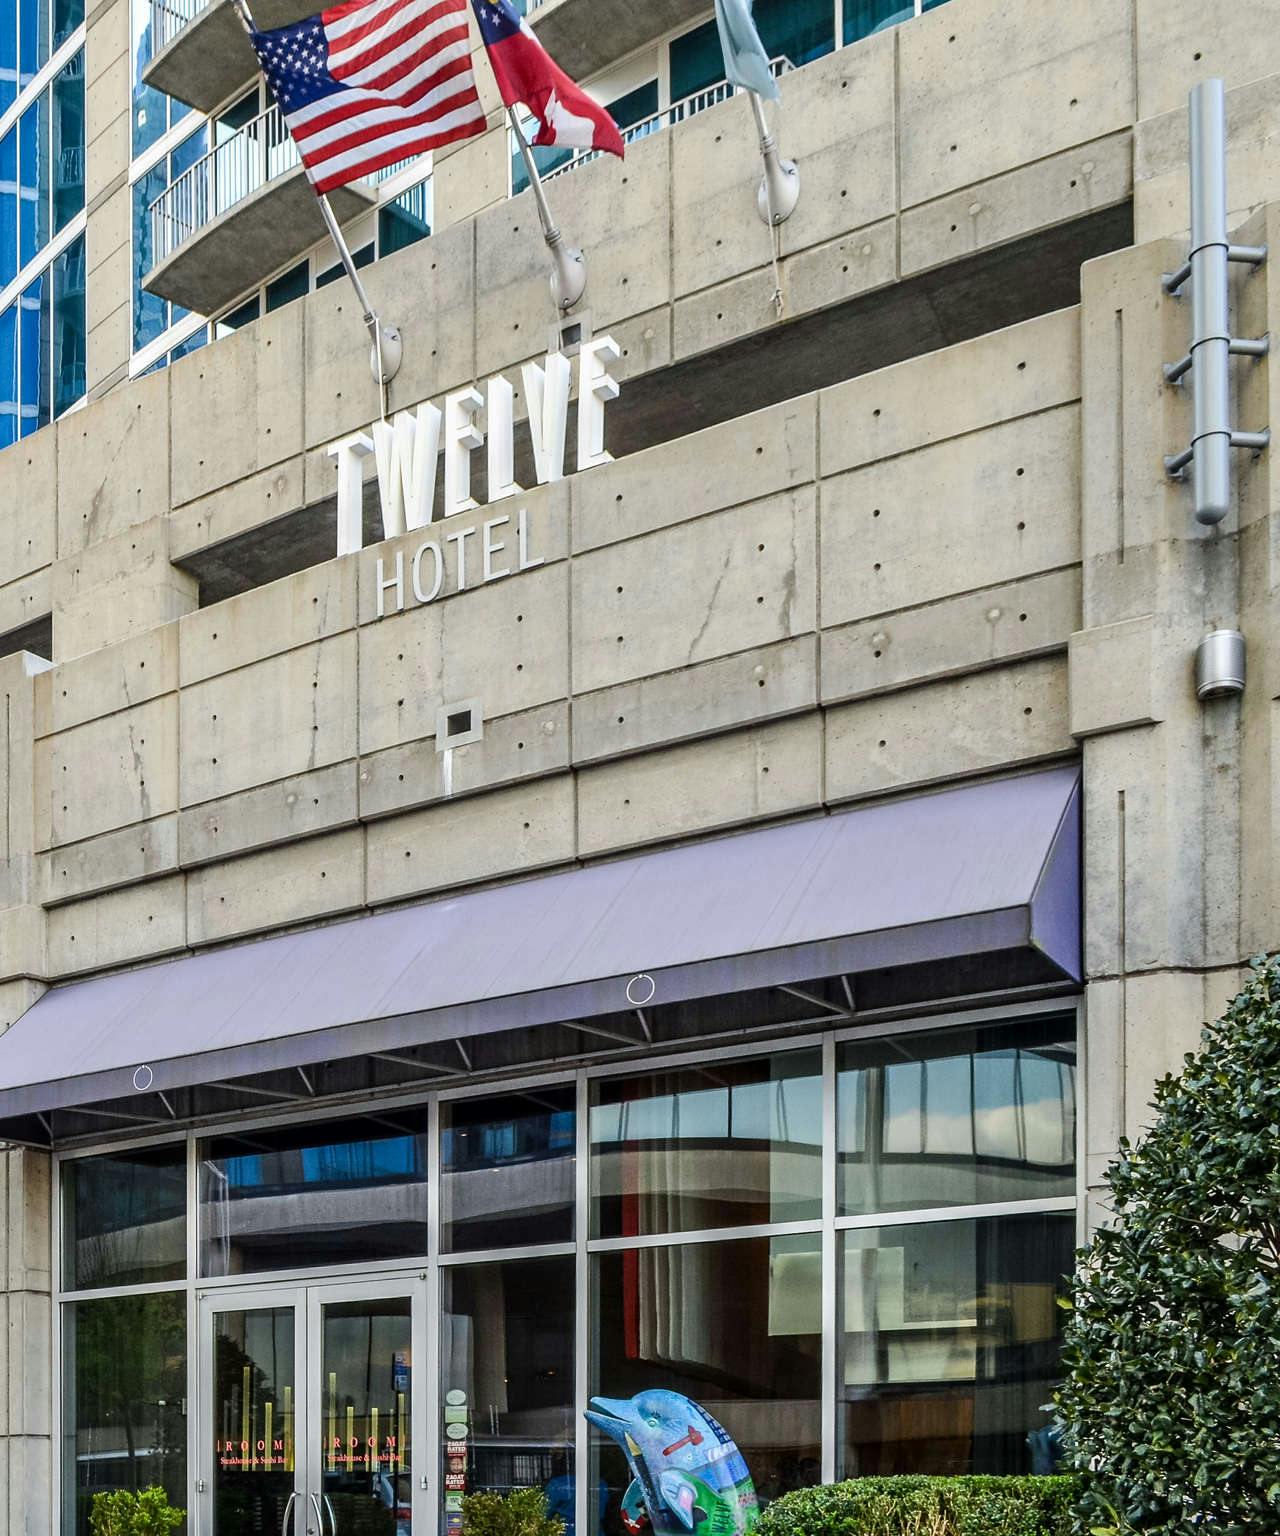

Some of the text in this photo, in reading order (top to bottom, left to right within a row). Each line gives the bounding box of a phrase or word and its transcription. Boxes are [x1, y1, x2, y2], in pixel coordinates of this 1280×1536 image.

[327, 335, 620, 558] TWELVE
[376, 508, 545, 617] HOTEL
[226, 1440, 283, 1451] ROOM
[333, 1435, 396, 1448] ROOM
